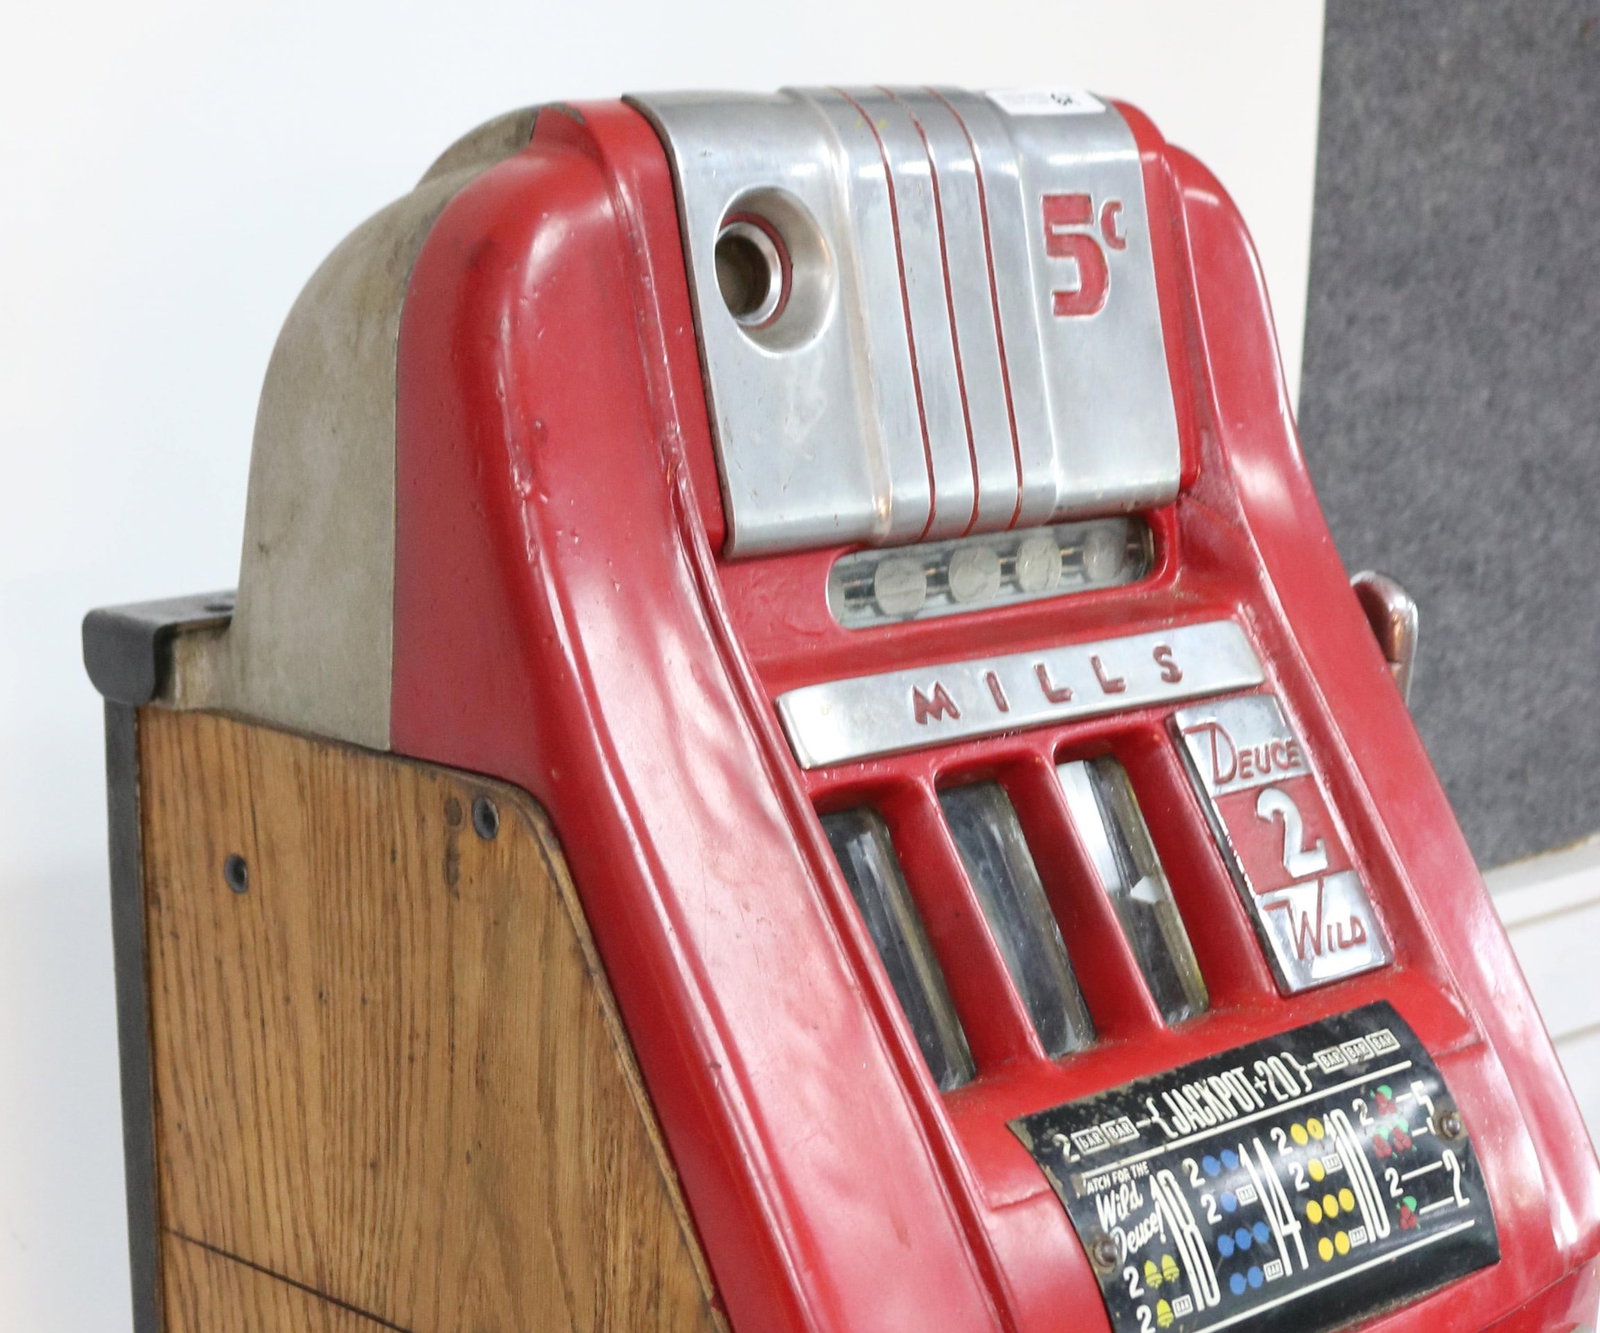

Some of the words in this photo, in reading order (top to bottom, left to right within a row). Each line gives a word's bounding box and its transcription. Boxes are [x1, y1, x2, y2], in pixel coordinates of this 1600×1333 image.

[911, 643, 1183, 725] MILLS
[1256, 787, 1329, 878] 2
[1052, 1133, 1081, 1163] 2
[1107, 1122, 1133, 1140] BAR
[1320, 1051, 1343, 1068] BAR
[1349, 1042, 1372, 1060] BAR
[1374, 1033, 1394, 1051] BAR
[1352, 1098, 1375, 1126] 2
[1270, 1126, 1294, 1156] 2
[1077, 1174, 1112, 1198] ATCH
[1112, 1167, 1132, 1184] FOR
[1130, 1161, 1150, 1179] THE
[1182, 1157, 1206, 1188] 2
[1288, 1161, 1310, 1191] 2
[1322, 1108, 1391, 1243] 10
[1385, 1167, 1404, 1198] 2
[1442, 1149, 1470, 1208] 2
[1096, 1180, 1144, 1233] Wild
[1200, 1193, 1223, 1225] 2
[1238, 1137, 1310, 1277] 14
[1149, 1168, 1221, 1312] 18
[1122, 1266, 1145, 1299] 2
